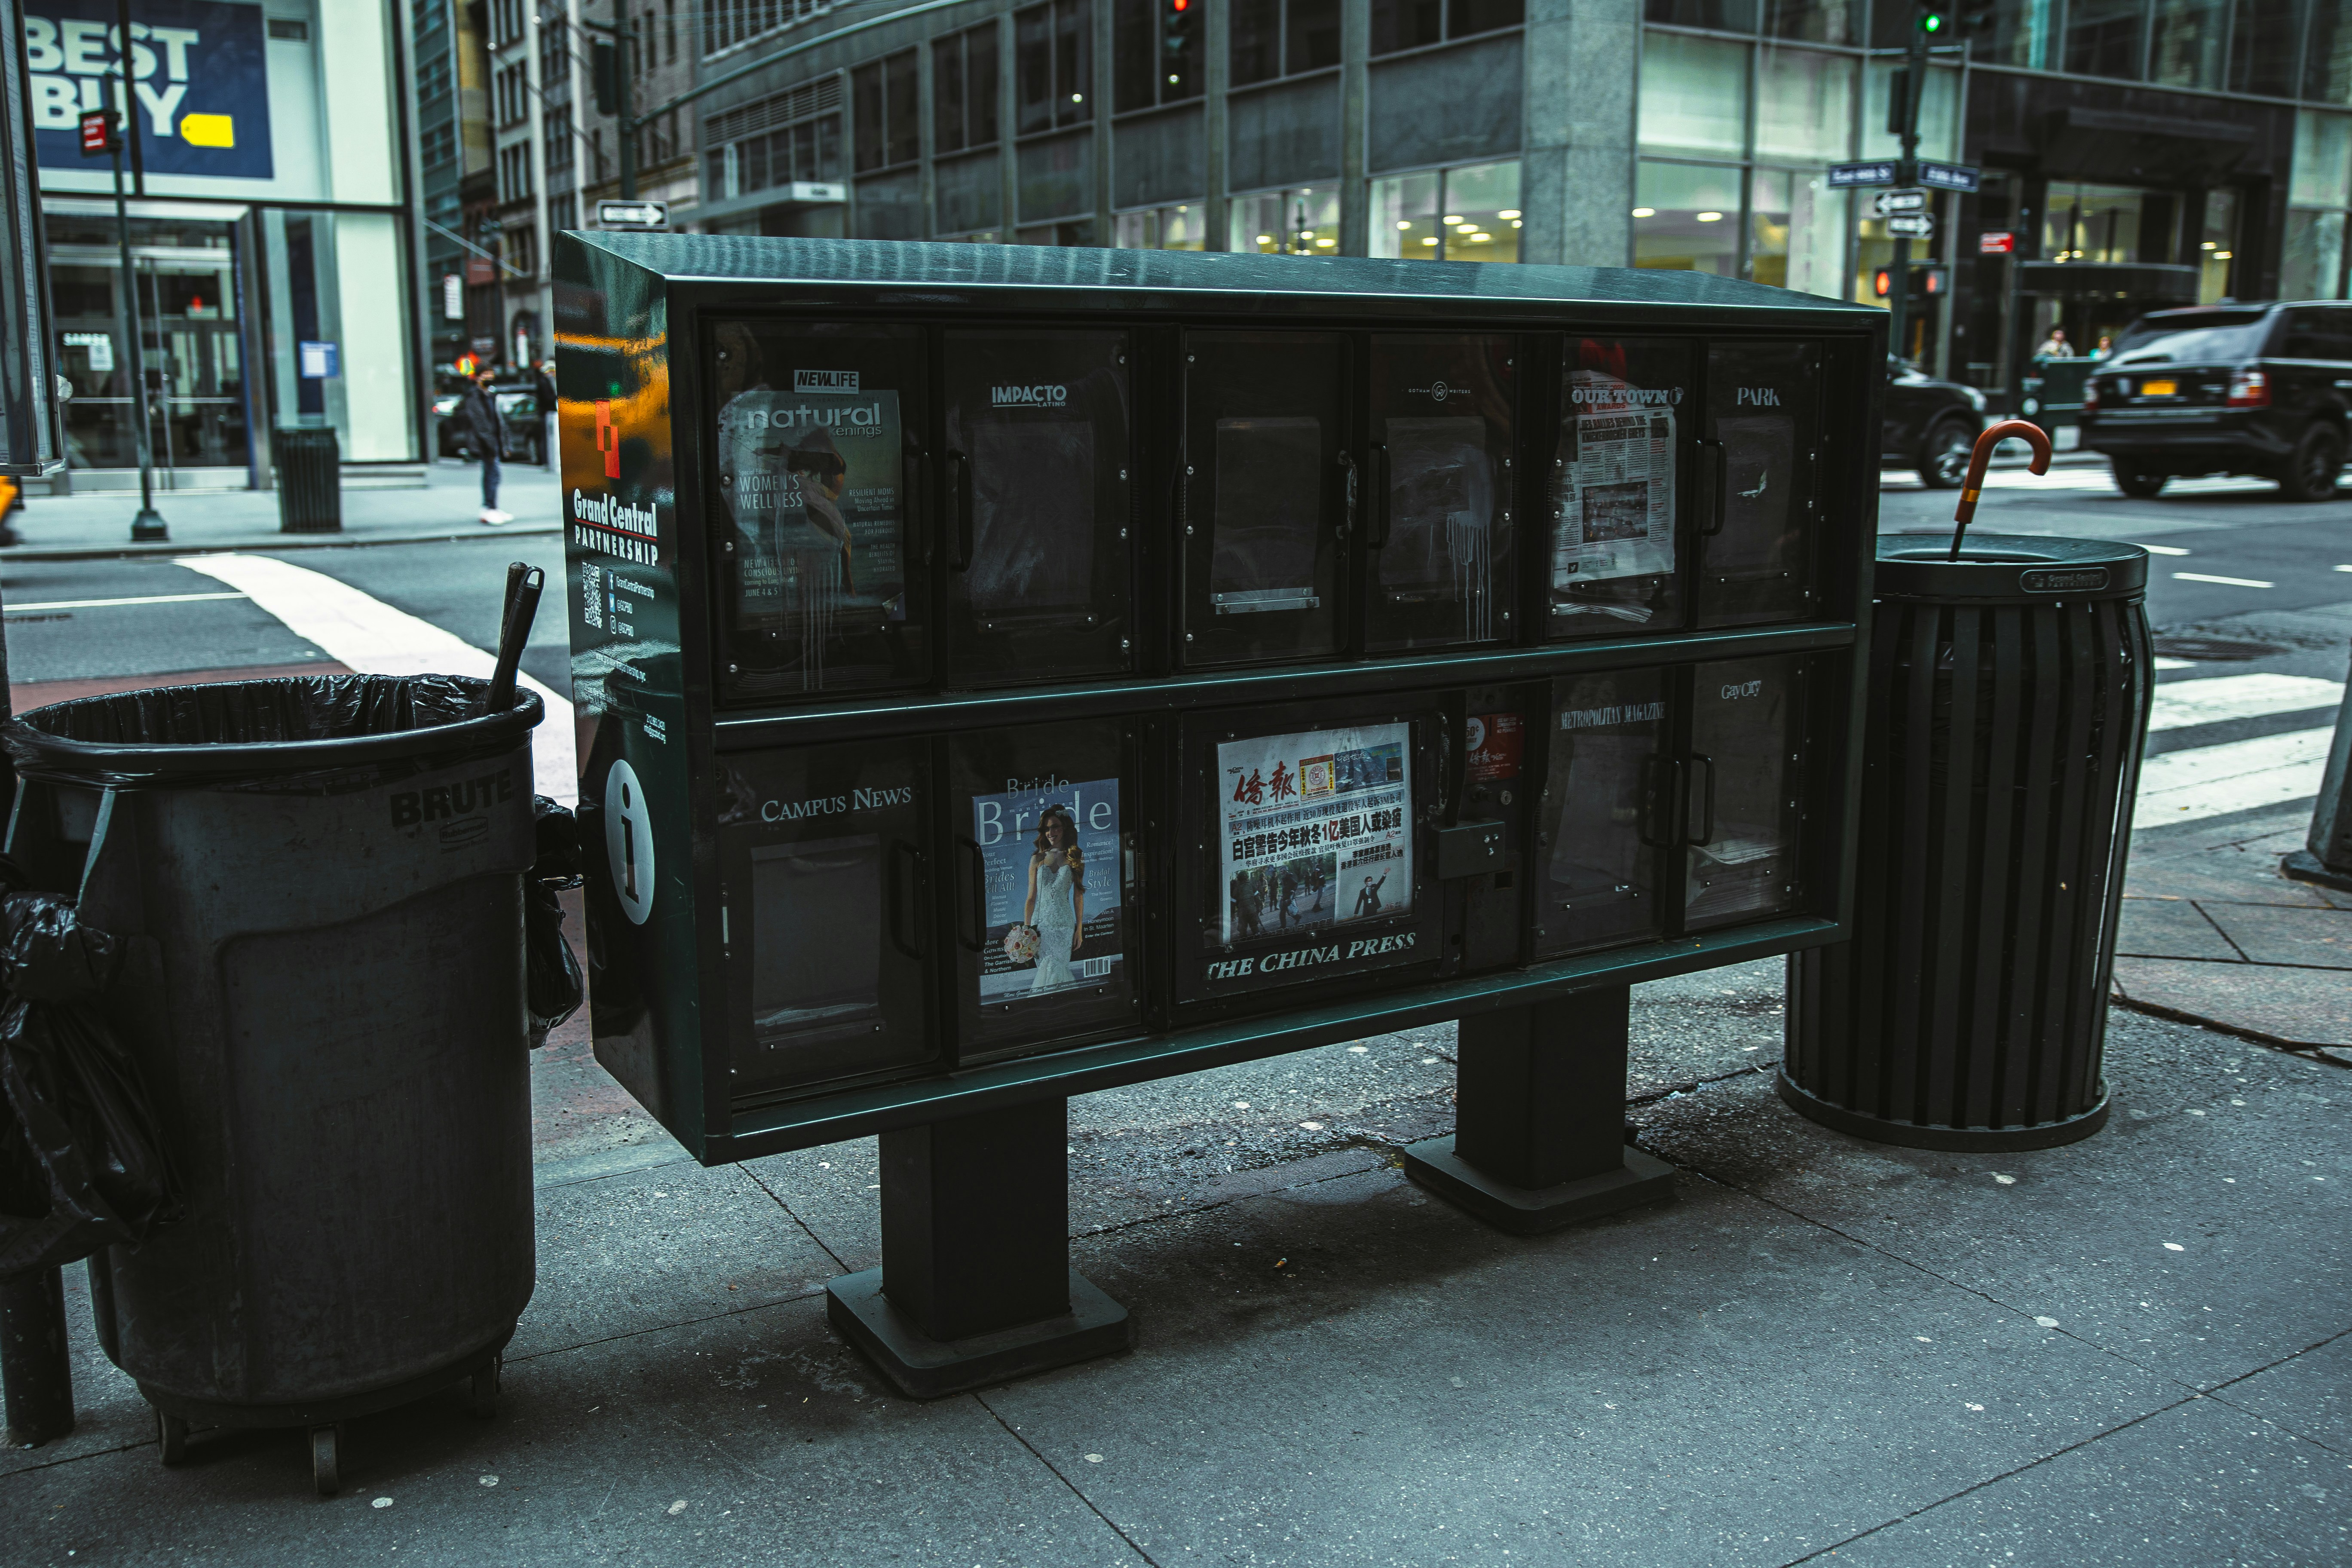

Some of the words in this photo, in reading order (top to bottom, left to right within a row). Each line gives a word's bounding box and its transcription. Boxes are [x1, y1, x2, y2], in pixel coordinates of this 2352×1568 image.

[24, 15, 199, 82] BEST
[30, 74, 187, 137] BUY
[797, 371, 856, 386] NEWLIFE
[992, 385, 1067, 403] IMPACTO
[1571, 389, 1610, 404] OUR
[1613, 389, 1669, 404] TOWN
[1736, 387, 1781, 406] PARK
[1596, 402, 1626, 410] AWARDS
[747, 403, 881, 430] natural
[739, 475, 799, 492] WOMEN'S
[849, 488, 876, 496] RESILIENT
[740, 491, 803, 510] WELLNESS
[855, 497, 872, 505] Moving
[574, 489, 609, 525] Grand
[609, 496, 658, 537] Central
[575, 525, 658, 567] PARTNERSHIP
[744, 567, 780, 577] CONSCIOUS
[744, 588, 760, 597] JUNE
[761, 588, 766, 596] 4
[774, 587, 778, 595] 5
[1560, 707, 1622, 730] METROPOLITAN
[1624, 701, 1666, 722] MAGAZINE
[1007, 774, 1069, 799] Bride
[390, 768, 512, 827] BRUTE
[978, 790, 1112, 846] Brde
[442, 821, 487, 839] Rubbermaid
[1231, 822, 1243, 833] A2
[1232, 806, 1403, 862] 白宫警告今年秋冬1亿美国人或染疫
[1086, 839, 1114, 848] Romance!
[1081, 848, 1114, 858] Inspiration!
[985, 871, 1015, 884] Brides
[1089, 867, 1110, 878] Bridal
[999, 882, 1015, 892] All!
[1087, 876, 1112, 891] Style
[1206, 956, 1255, 980] THE
[1259, 944, 1340, 973] CHINA
[1346, 931, 1416, 959] PRESS
